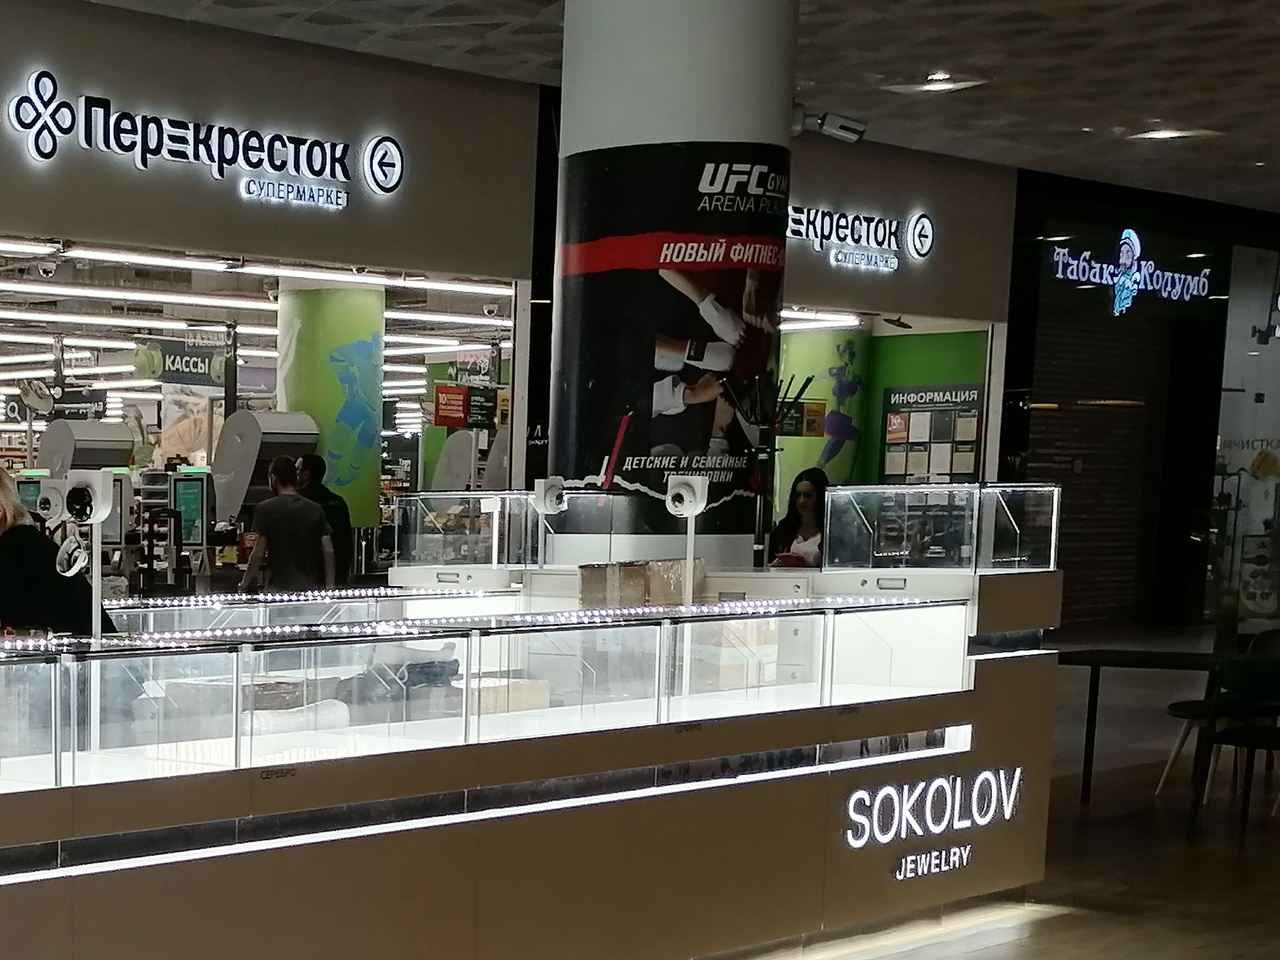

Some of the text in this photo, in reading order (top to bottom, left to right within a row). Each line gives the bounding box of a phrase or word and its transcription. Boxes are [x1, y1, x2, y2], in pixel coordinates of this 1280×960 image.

[698, 163, 769, 195] UFC
[243, 179, 351, 207] СУПЕРМАРКЕТ
[697, 195, 755, 212] ARENA
[659, 238, 727, 264] НОВЫЙ
[1053, 246, 1211, 301] Табак Колумб
[165, 354, 210, 375] КАССЫ
[890, 389, 979, 405] ИНФОРМАЦИЯ
[622, 454, 748, 471] ДЕТСКИЕ И СЕМЕЙНЫЕ
[846, 767, 1022, 848] SOKOLOV
[895, 845, 972, 880] JEWELRY
